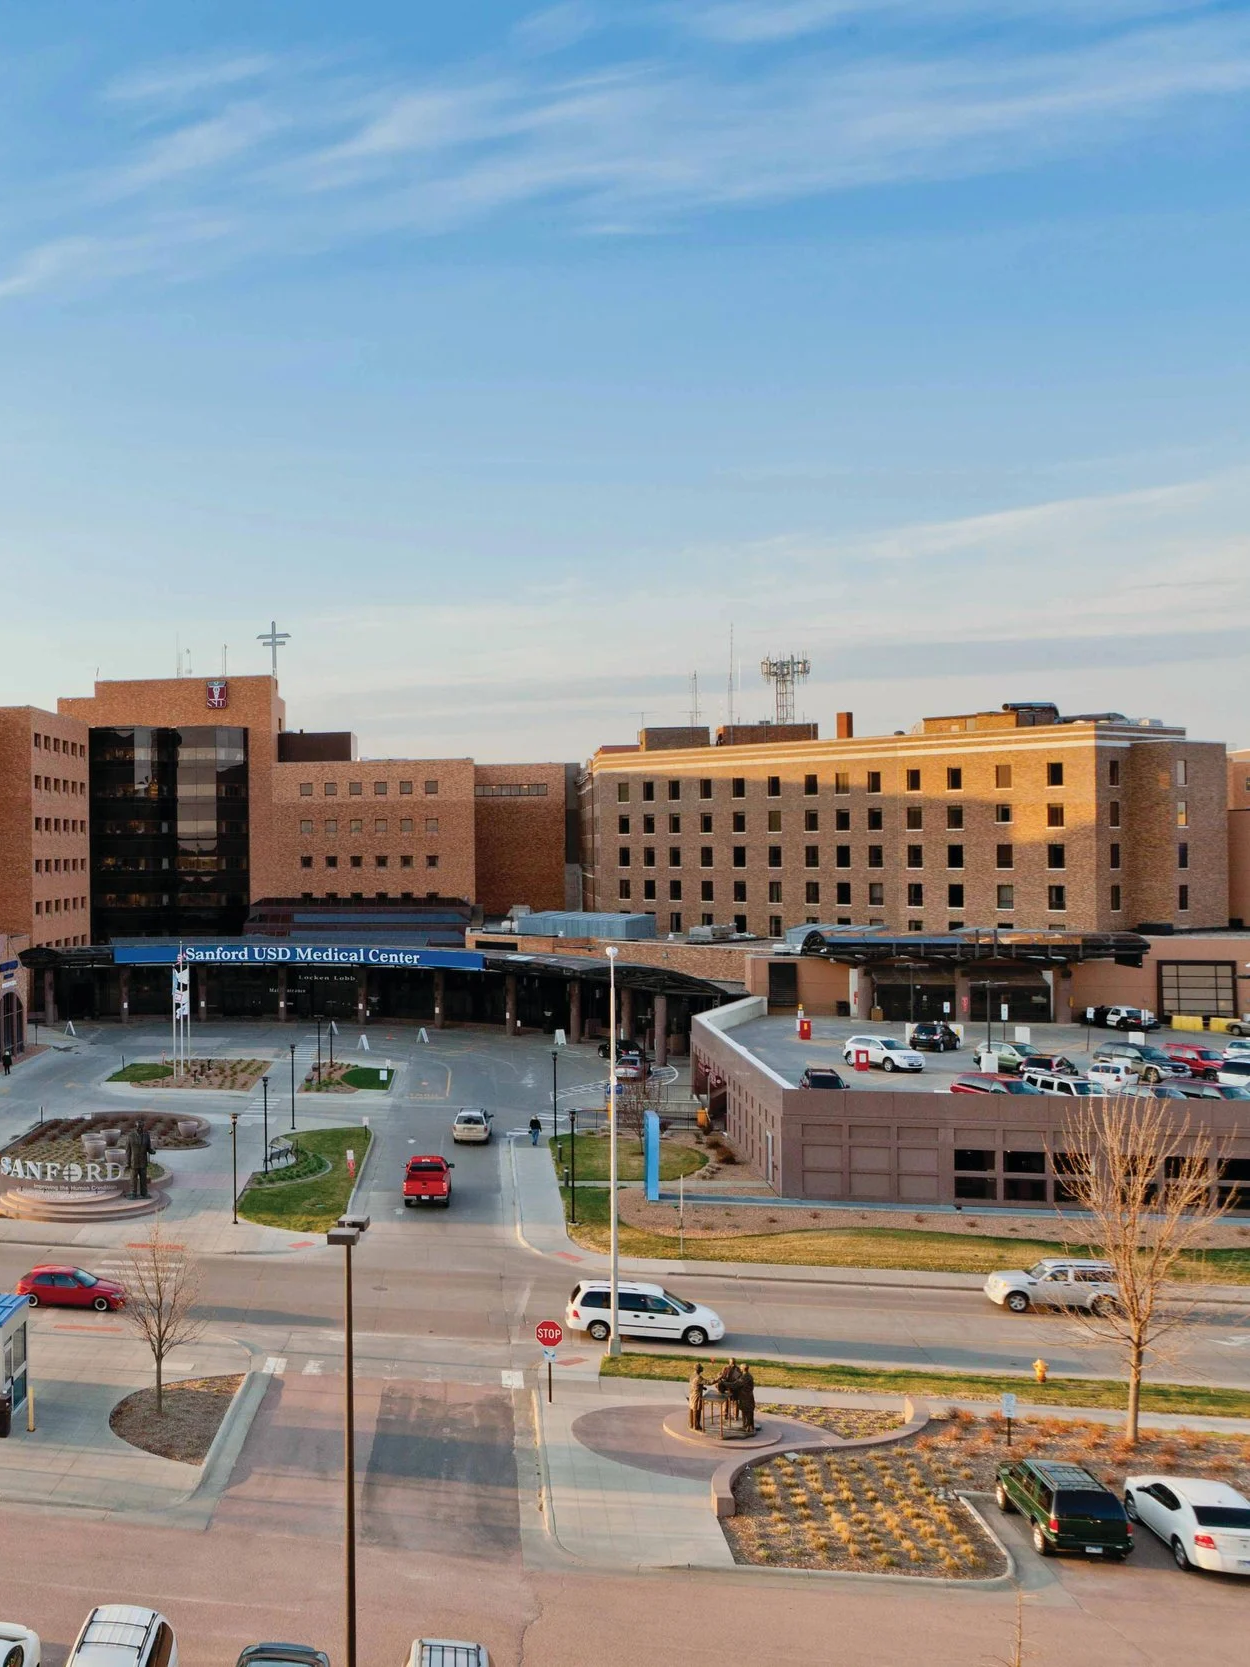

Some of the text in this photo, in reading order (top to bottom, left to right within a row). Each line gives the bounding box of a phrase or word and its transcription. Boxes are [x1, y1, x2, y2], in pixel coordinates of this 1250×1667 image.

[185, 947, 420, 964] Sanford USD Medical Center
[334, 975, 359, 983] Lobb
[0, 1156, 125, 1182] SANFORD
[537, 1328, 561, 1339] STOP
